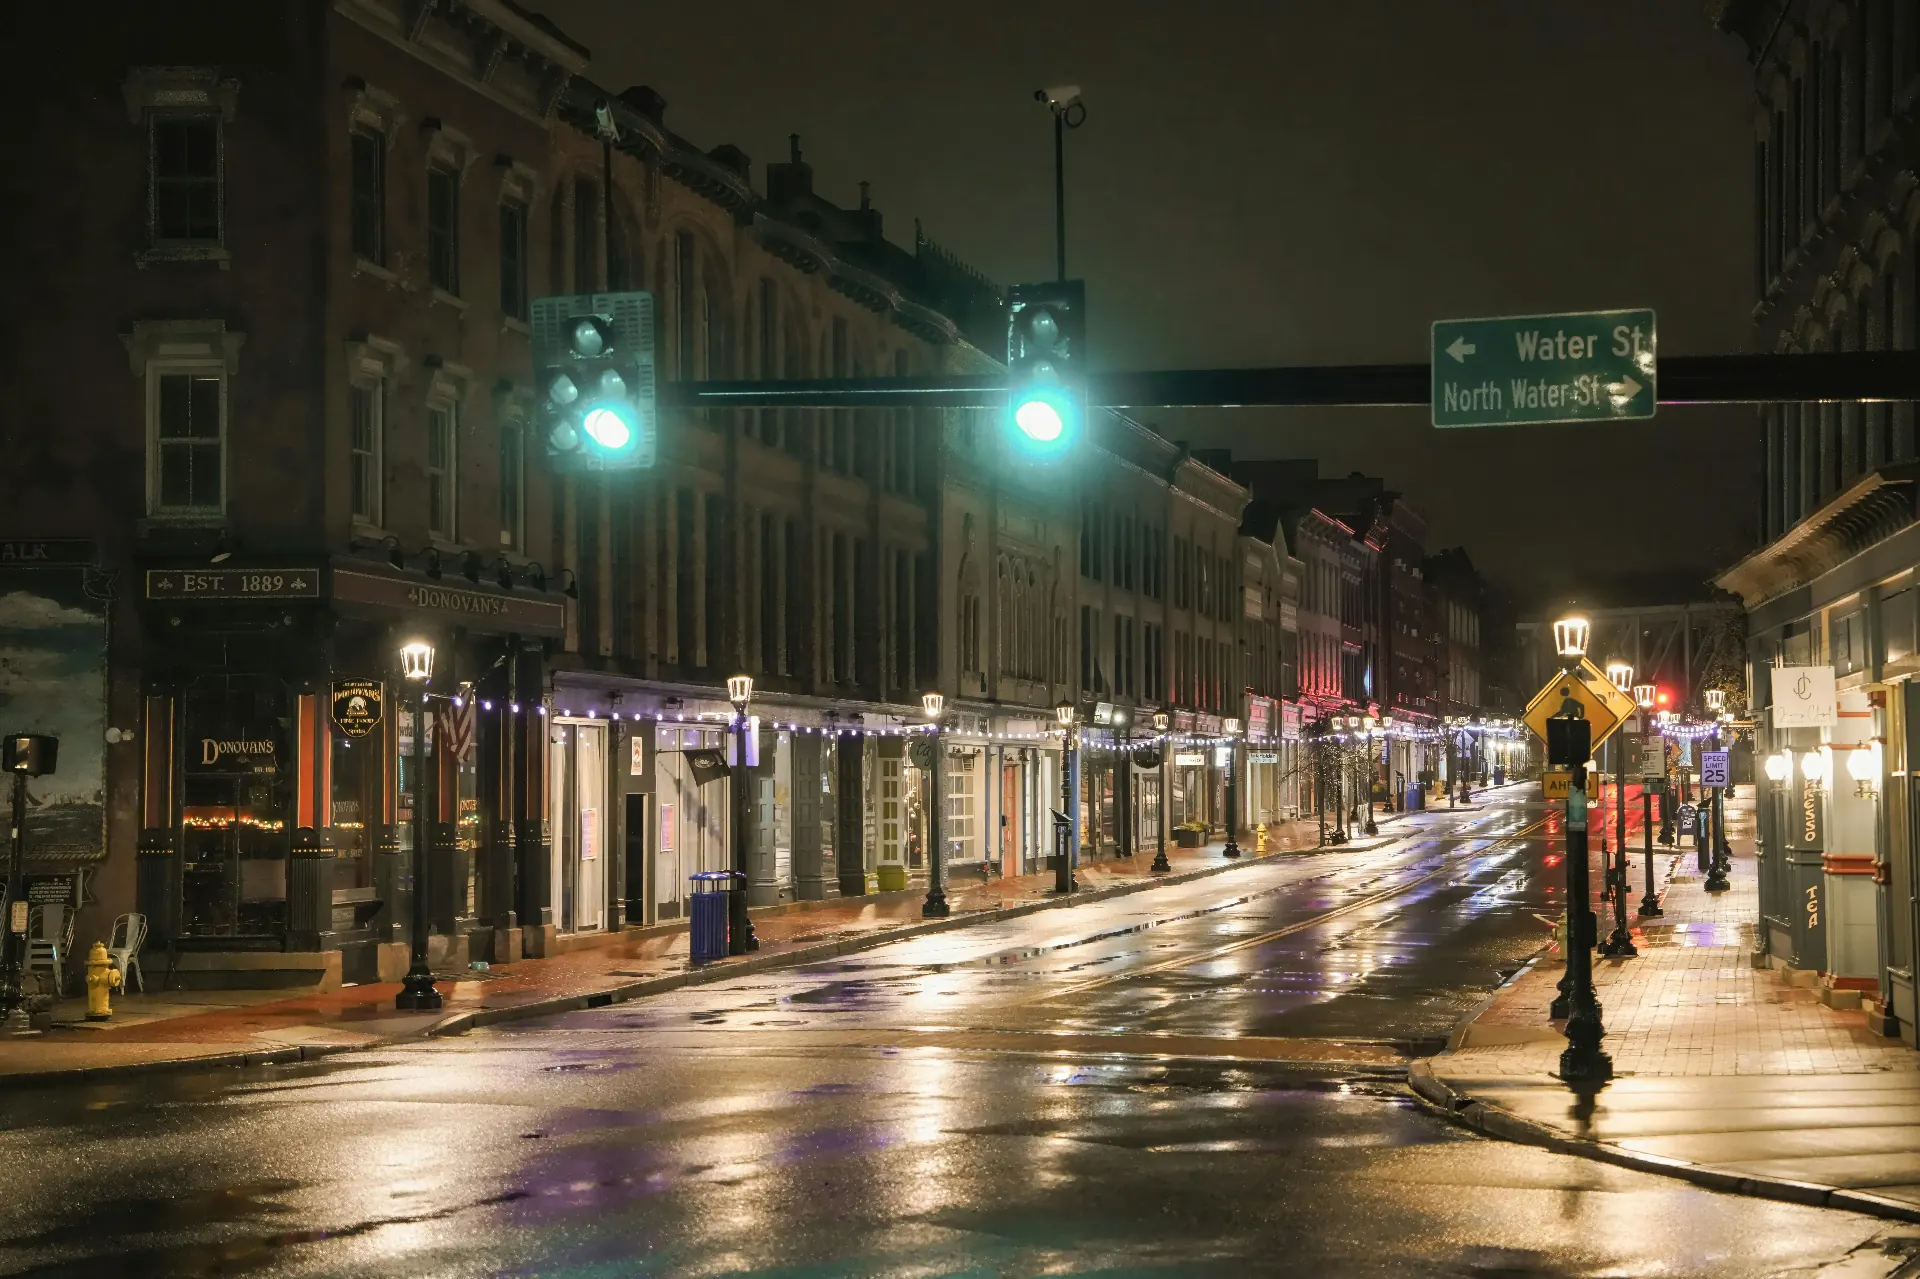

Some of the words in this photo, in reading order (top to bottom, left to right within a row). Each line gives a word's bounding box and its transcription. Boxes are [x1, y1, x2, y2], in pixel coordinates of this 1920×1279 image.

[1515, 330, 1598, 362] Water
[1612, 325, 1642, 360] St
[1444, 380, 1502, 412] North
[1510, 378, 1569, 409] Water
[1579, 374, 1600, 406] St
[183, 574, 225, 592] EST.
[241, 575, 284, 592] 1889
[418, 587, 500, 615] DONOVAN'S
[201, 738, 274, 765] DONOVAN'S
[1704, 769, 1726, 783] 25
[1805, 885, 1818, 929] TEA
